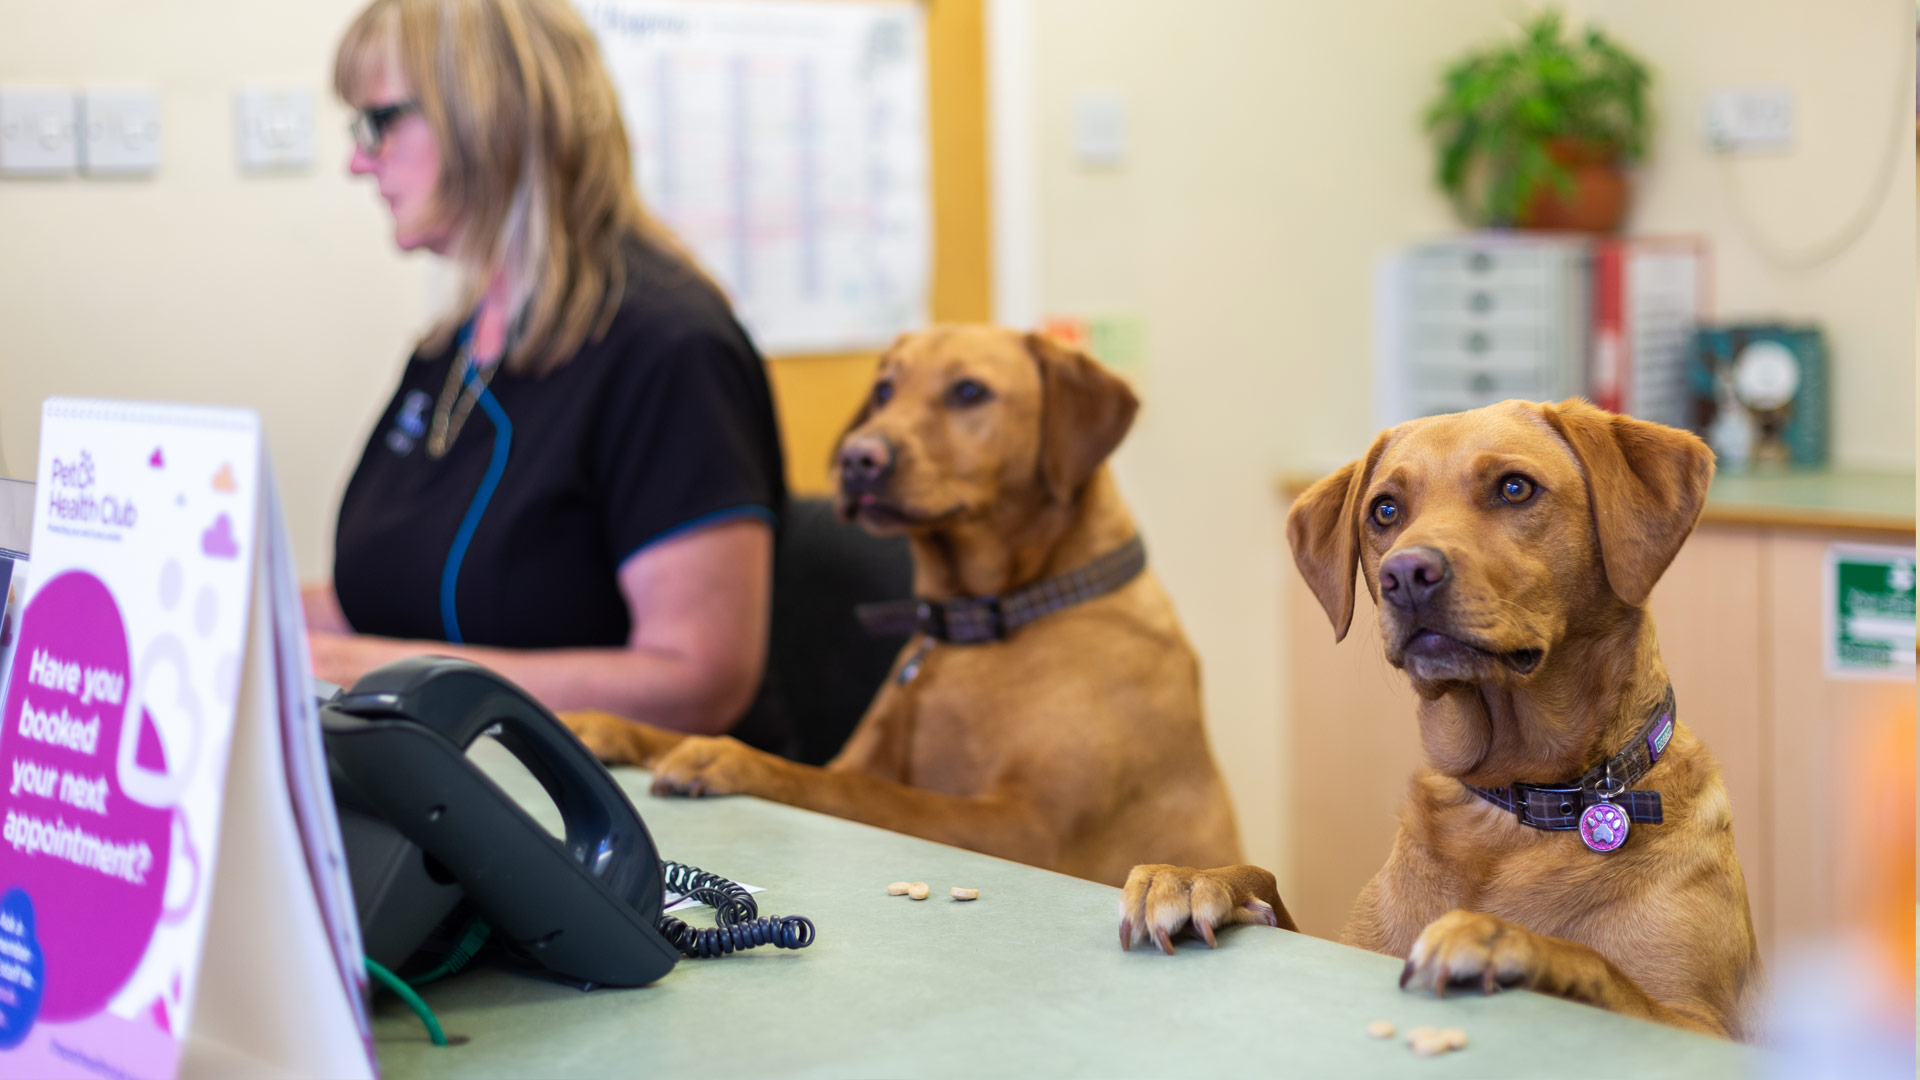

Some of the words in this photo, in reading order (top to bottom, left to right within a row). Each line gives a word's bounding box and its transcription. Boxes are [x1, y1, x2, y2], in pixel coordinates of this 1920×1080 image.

[51, 458, 77, 487] Pet
[48, 491, 99, 521] Health
[100, 495, 138, 528] Club
[28, 649, 81, 695] Have
[80, 666, 125, 705] you
[18, 697, 100, 755] booked
[9, 758, 59, 797] your
[59, 772, 110, 816] next
[3, 808, 154, 885] appointment?
